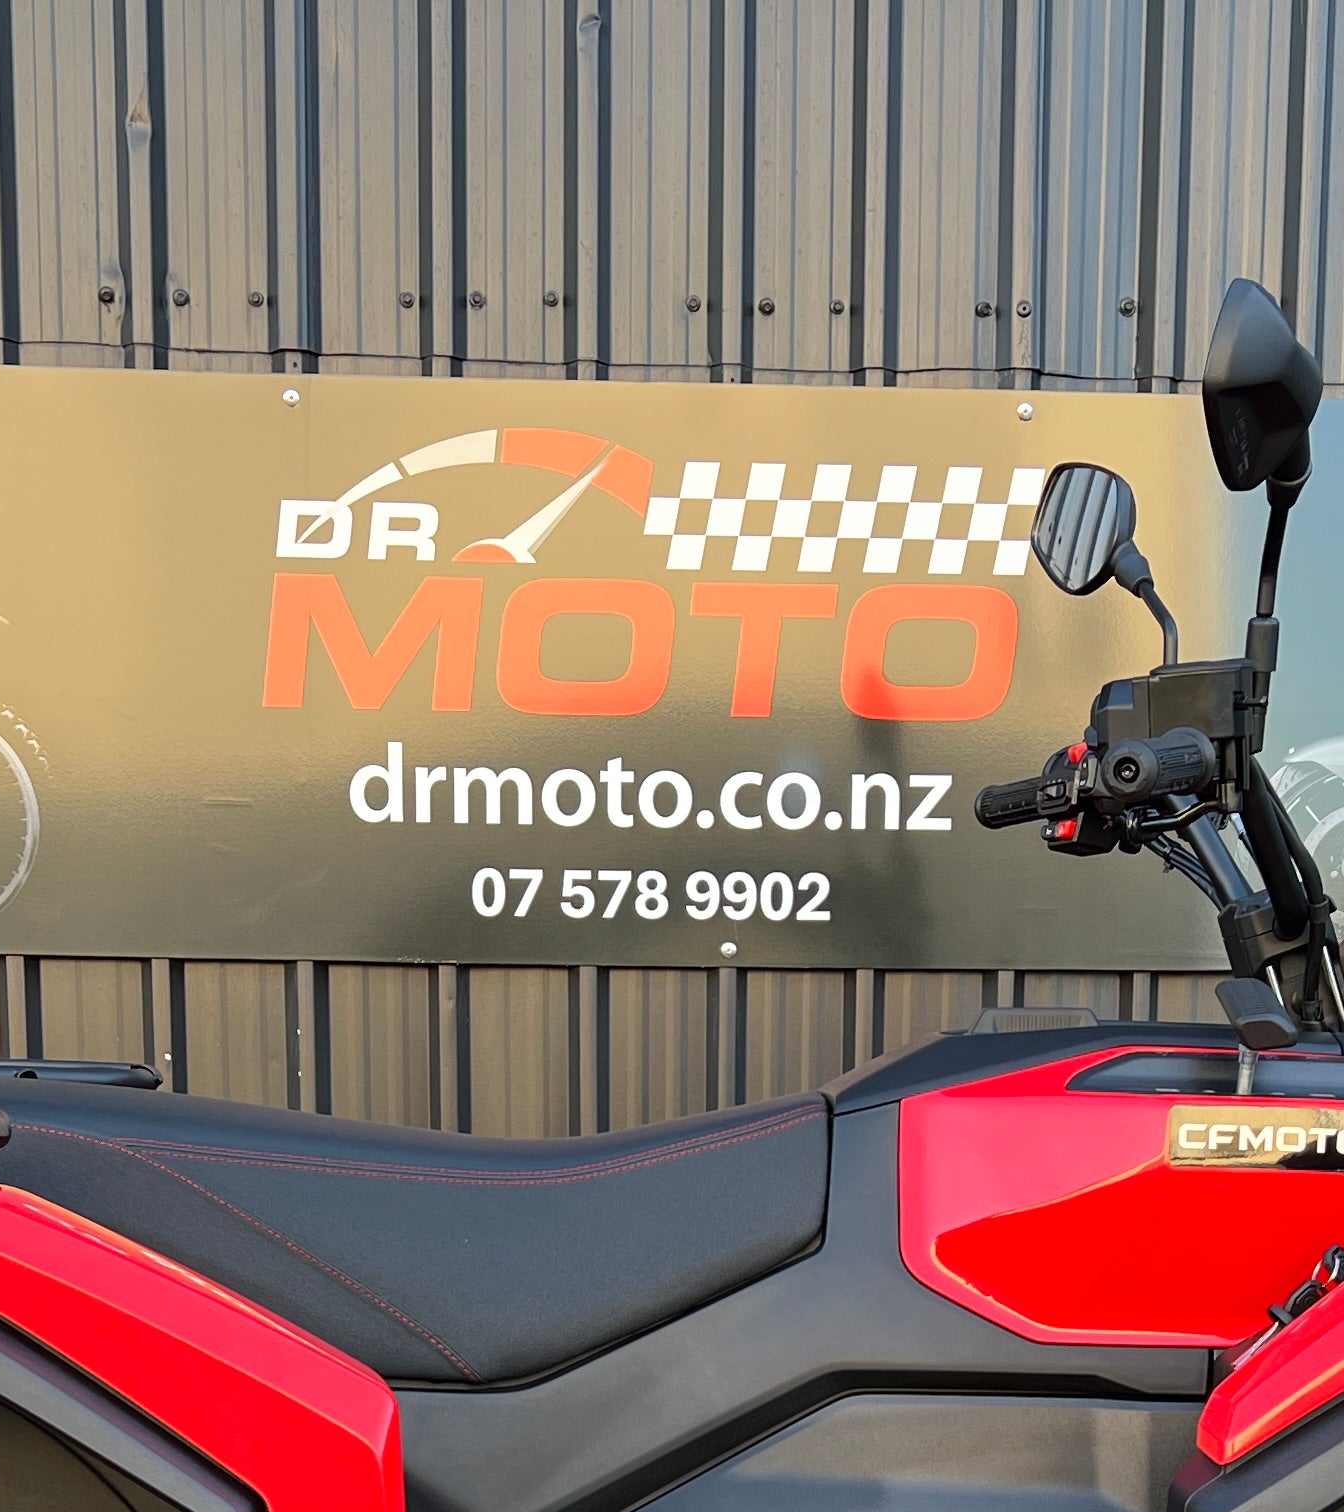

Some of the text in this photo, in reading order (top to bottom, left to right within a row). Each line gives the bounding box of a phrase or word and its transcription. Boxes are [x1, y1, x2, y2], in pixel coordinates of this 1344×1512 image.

[276, 499, 440, 562] DR
[262, 573, 1019, 722] MOTO
[348, 741, 953, 831] drmoto.co.nz
[471, 867, 832, 922] 07 578 9902
